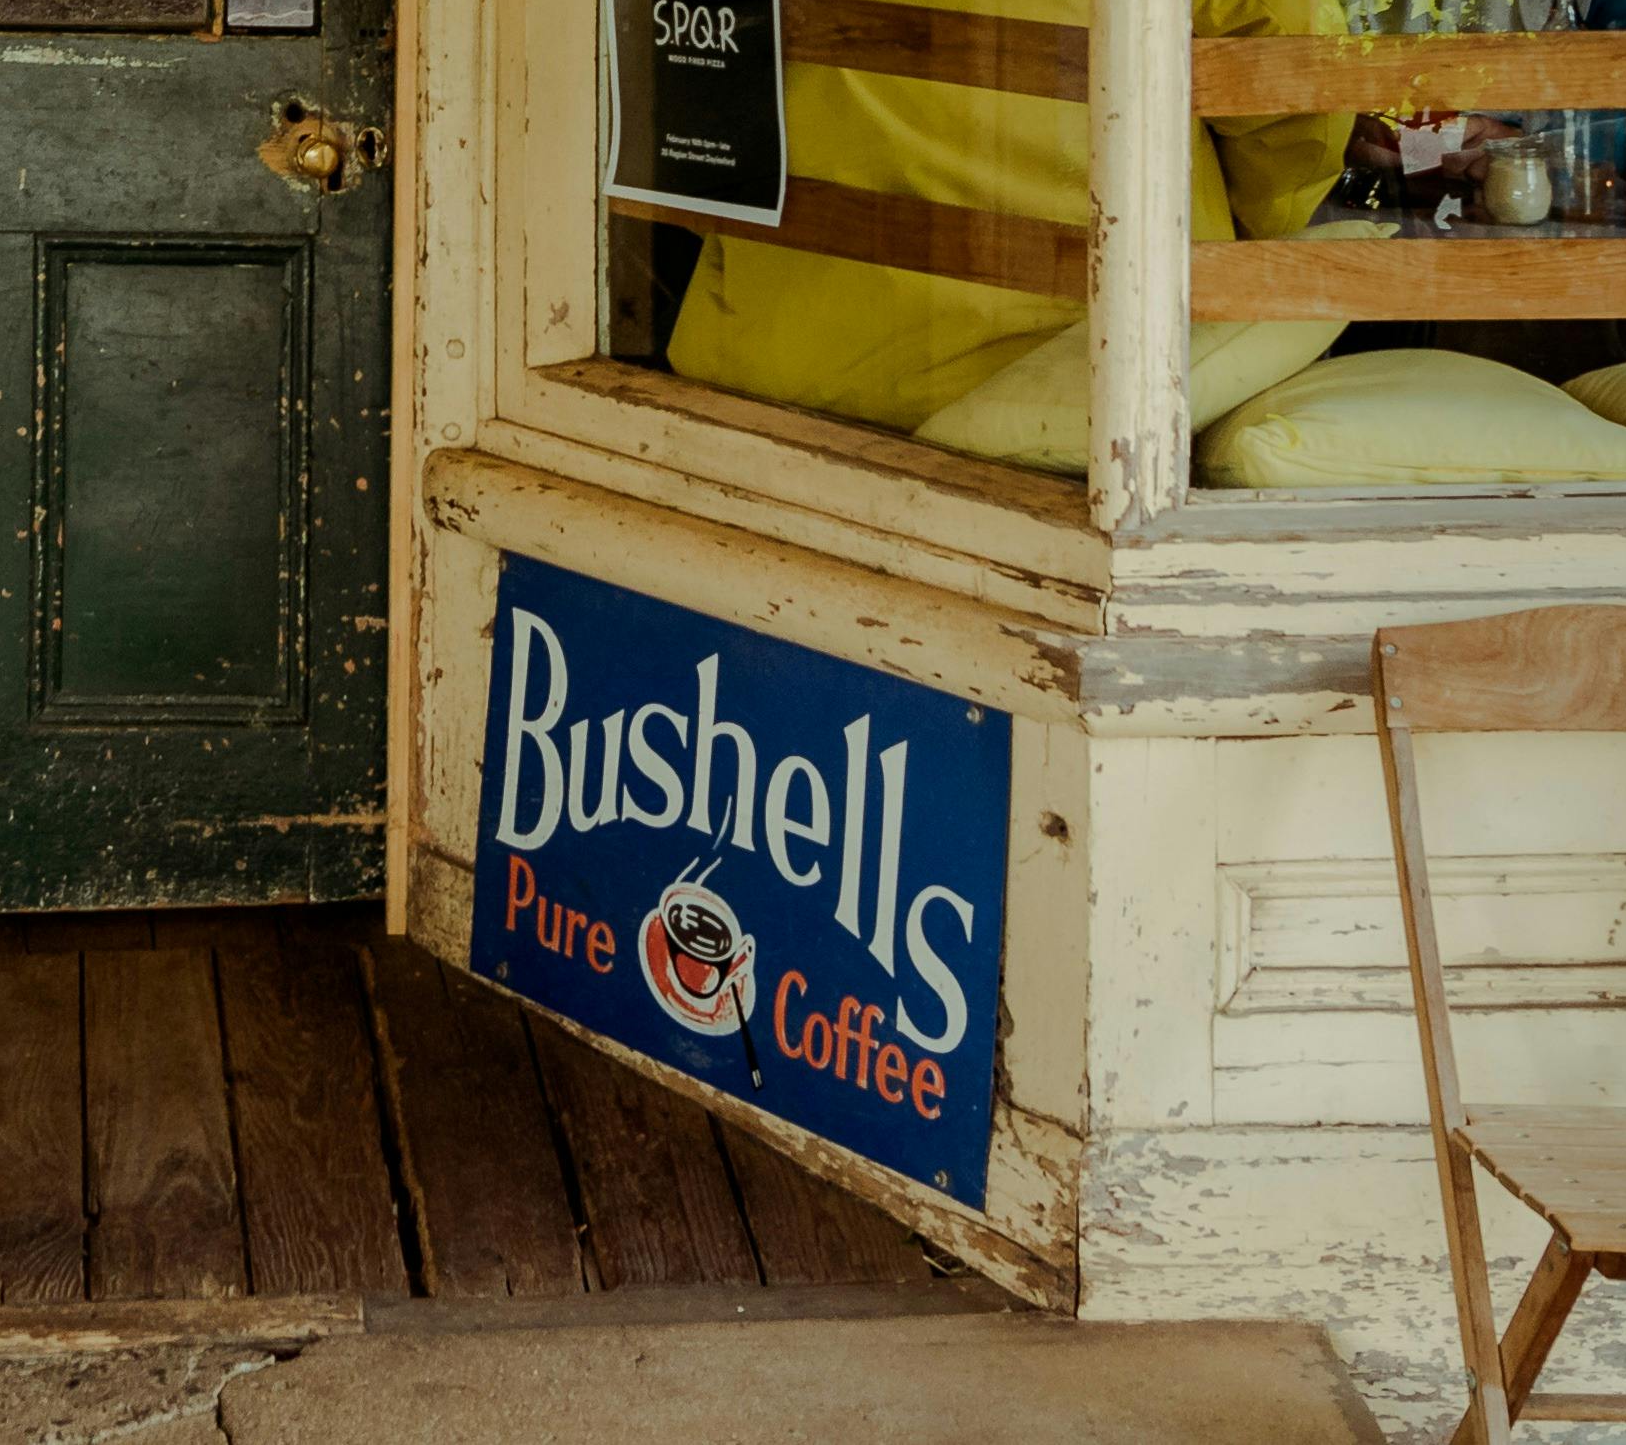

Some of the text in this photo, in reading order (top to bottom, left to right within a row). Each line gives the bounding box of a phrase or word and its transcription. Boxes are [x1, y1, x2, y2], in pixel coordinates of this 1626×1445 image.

[495, 607, 975, 1054] Bushells
[505, 855, 947, 1120] Pure Coffee
